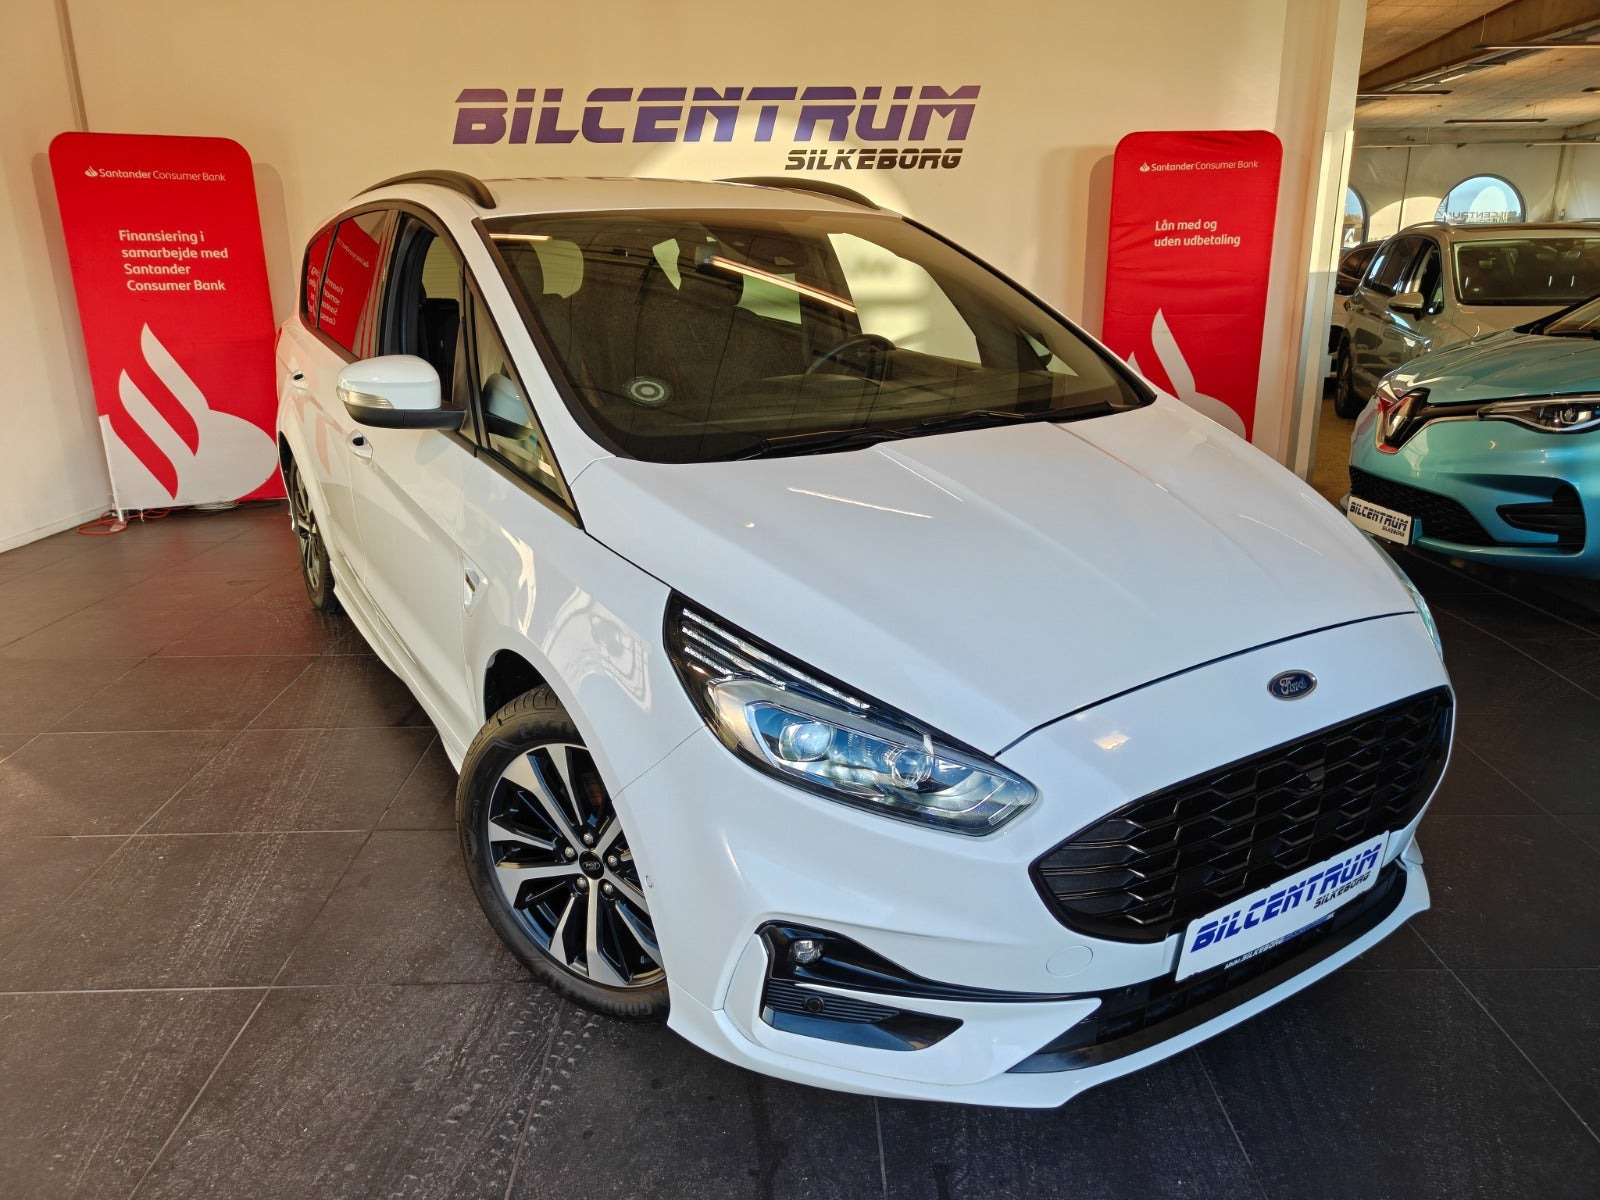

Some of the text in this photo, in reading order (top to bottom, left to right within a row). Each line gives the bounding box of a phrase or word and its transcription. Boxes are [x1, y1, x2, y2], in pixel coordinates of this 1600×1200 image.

[452, 85, 981, 144] BILCENTRUM
[785, 148, 963, 171] SILKEBORG
[1151, 160, 1258, 172] Santander Consumer Bank
[98, 168, 226, 182] Santander Consumer Bank
[1155, 218, 1218, 232] Lån med og
[118, 229, 205, 245] Finansiering i
[1154, 233, 1241, 247] uden udbetaling
[121, 246, 229, 261] samarbejde med
[123, 262, 191, 275] Santander
[126, 279, 226, 292] Consumer Bank
[1349, 501, 1409, 532] BILCENTRUM
[1280, 675, 1308, 695] Ford
[1313, 870, 1371, 909] SILKEBORG
[1190, 843, 1383, 954] BILCENTRUM
